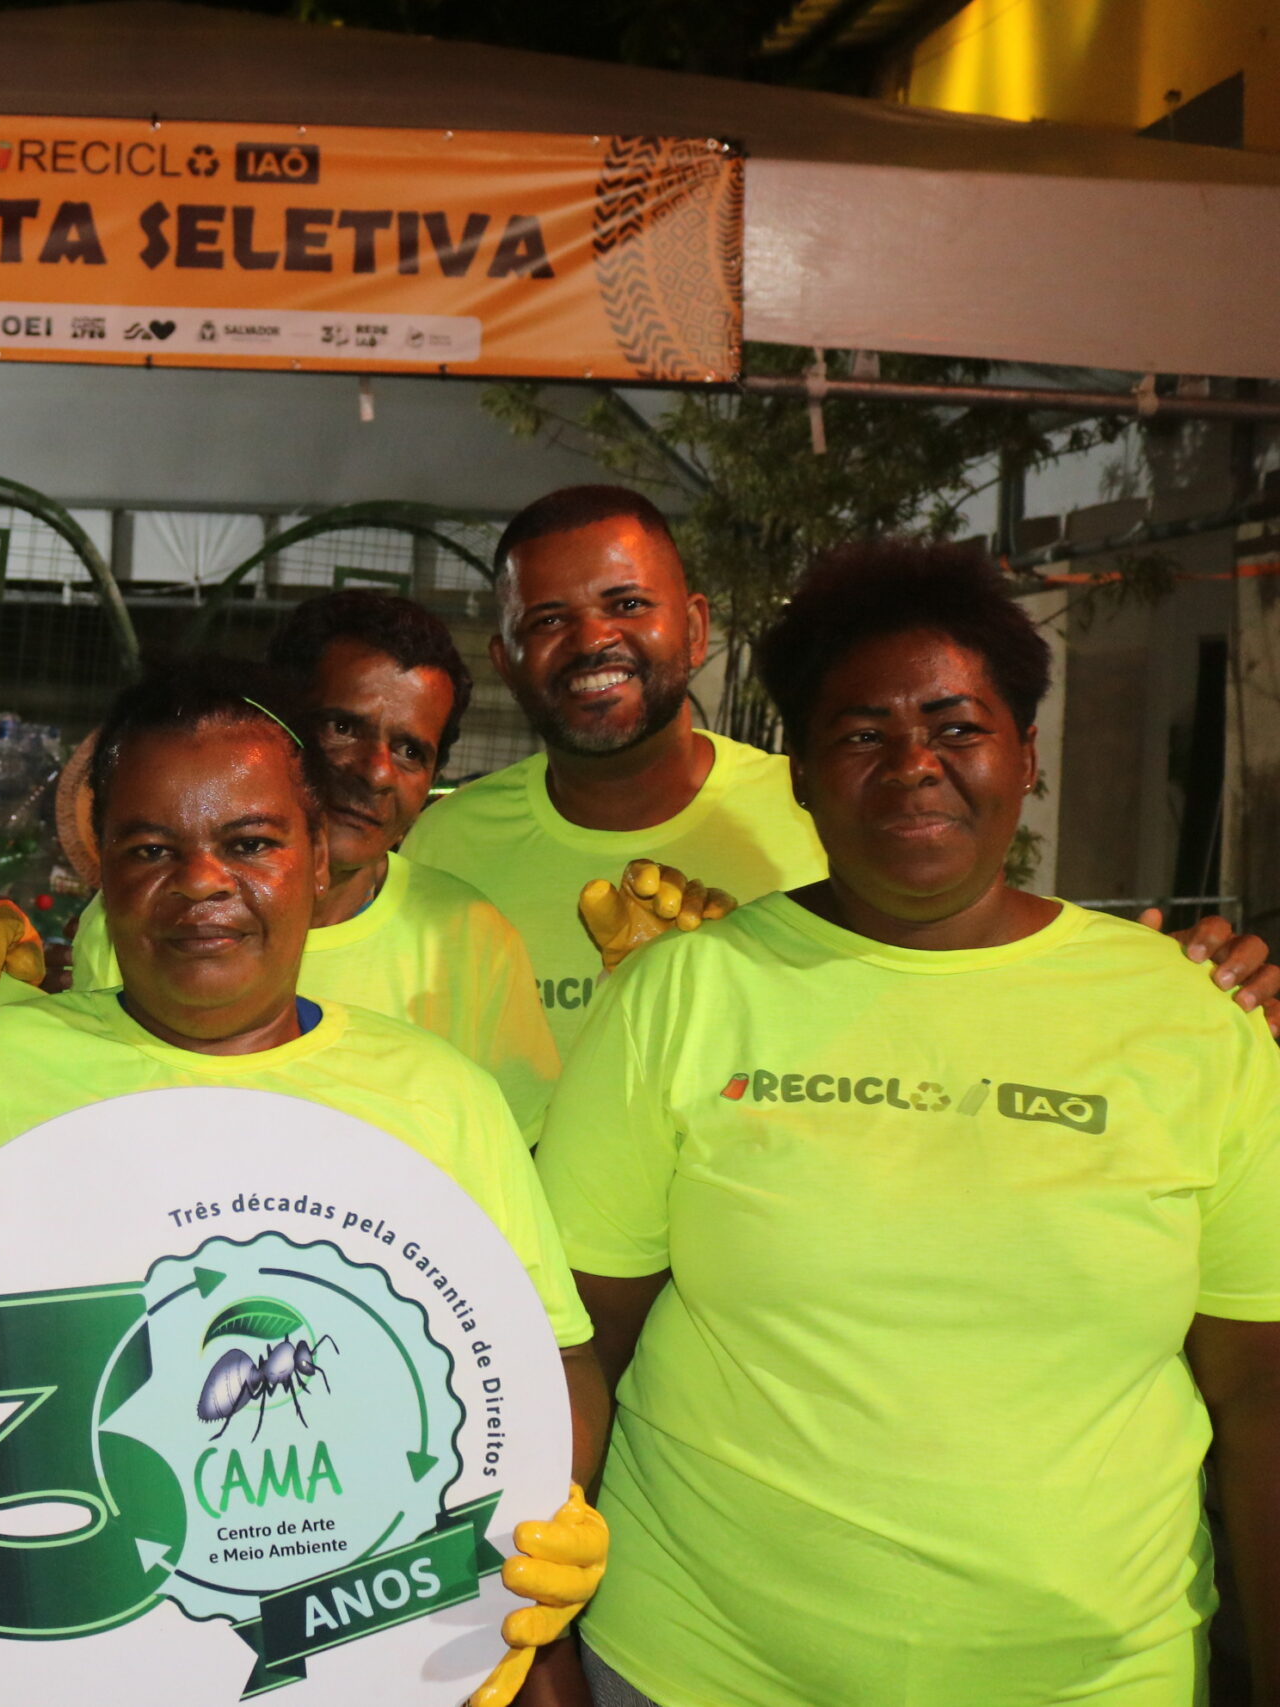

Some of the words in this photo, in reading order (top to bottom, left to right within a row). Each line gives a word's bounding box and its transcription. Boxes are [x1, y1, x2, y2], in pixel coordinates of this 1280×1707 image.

[246, 148, 309, 178] IAÔ
[138, 200, 556, 279] SELETIVA
[1, 315, 52, 336] OEI
[224, 324, 279, 336] SALVADOR
[1014, 1092, 1093, 1123] IAÔ
[168, 1201, 221, 1228] Três
[231, 1193, 336, 1220] décadas
[342, 1211, 397, 1246] pela
[402, 1241, 477, 1333] Garantia
[471, 1340, 492, 1369] de
[482, 1377, 505, 1477] Direitos
[194, 1440, 343, 1519] CAMA
[217, 1525, 272, 1541] Centro
[277, 1521, 297, 1536] de
[301, 1518, 335, 1533] Arte
[209, 1553, 219, 1564] e
[223, 1546, 264, 1562] Meio
[269, 1539, 348, 1558] Ambiente
[305, 1557, 441, 1638] ANOS
